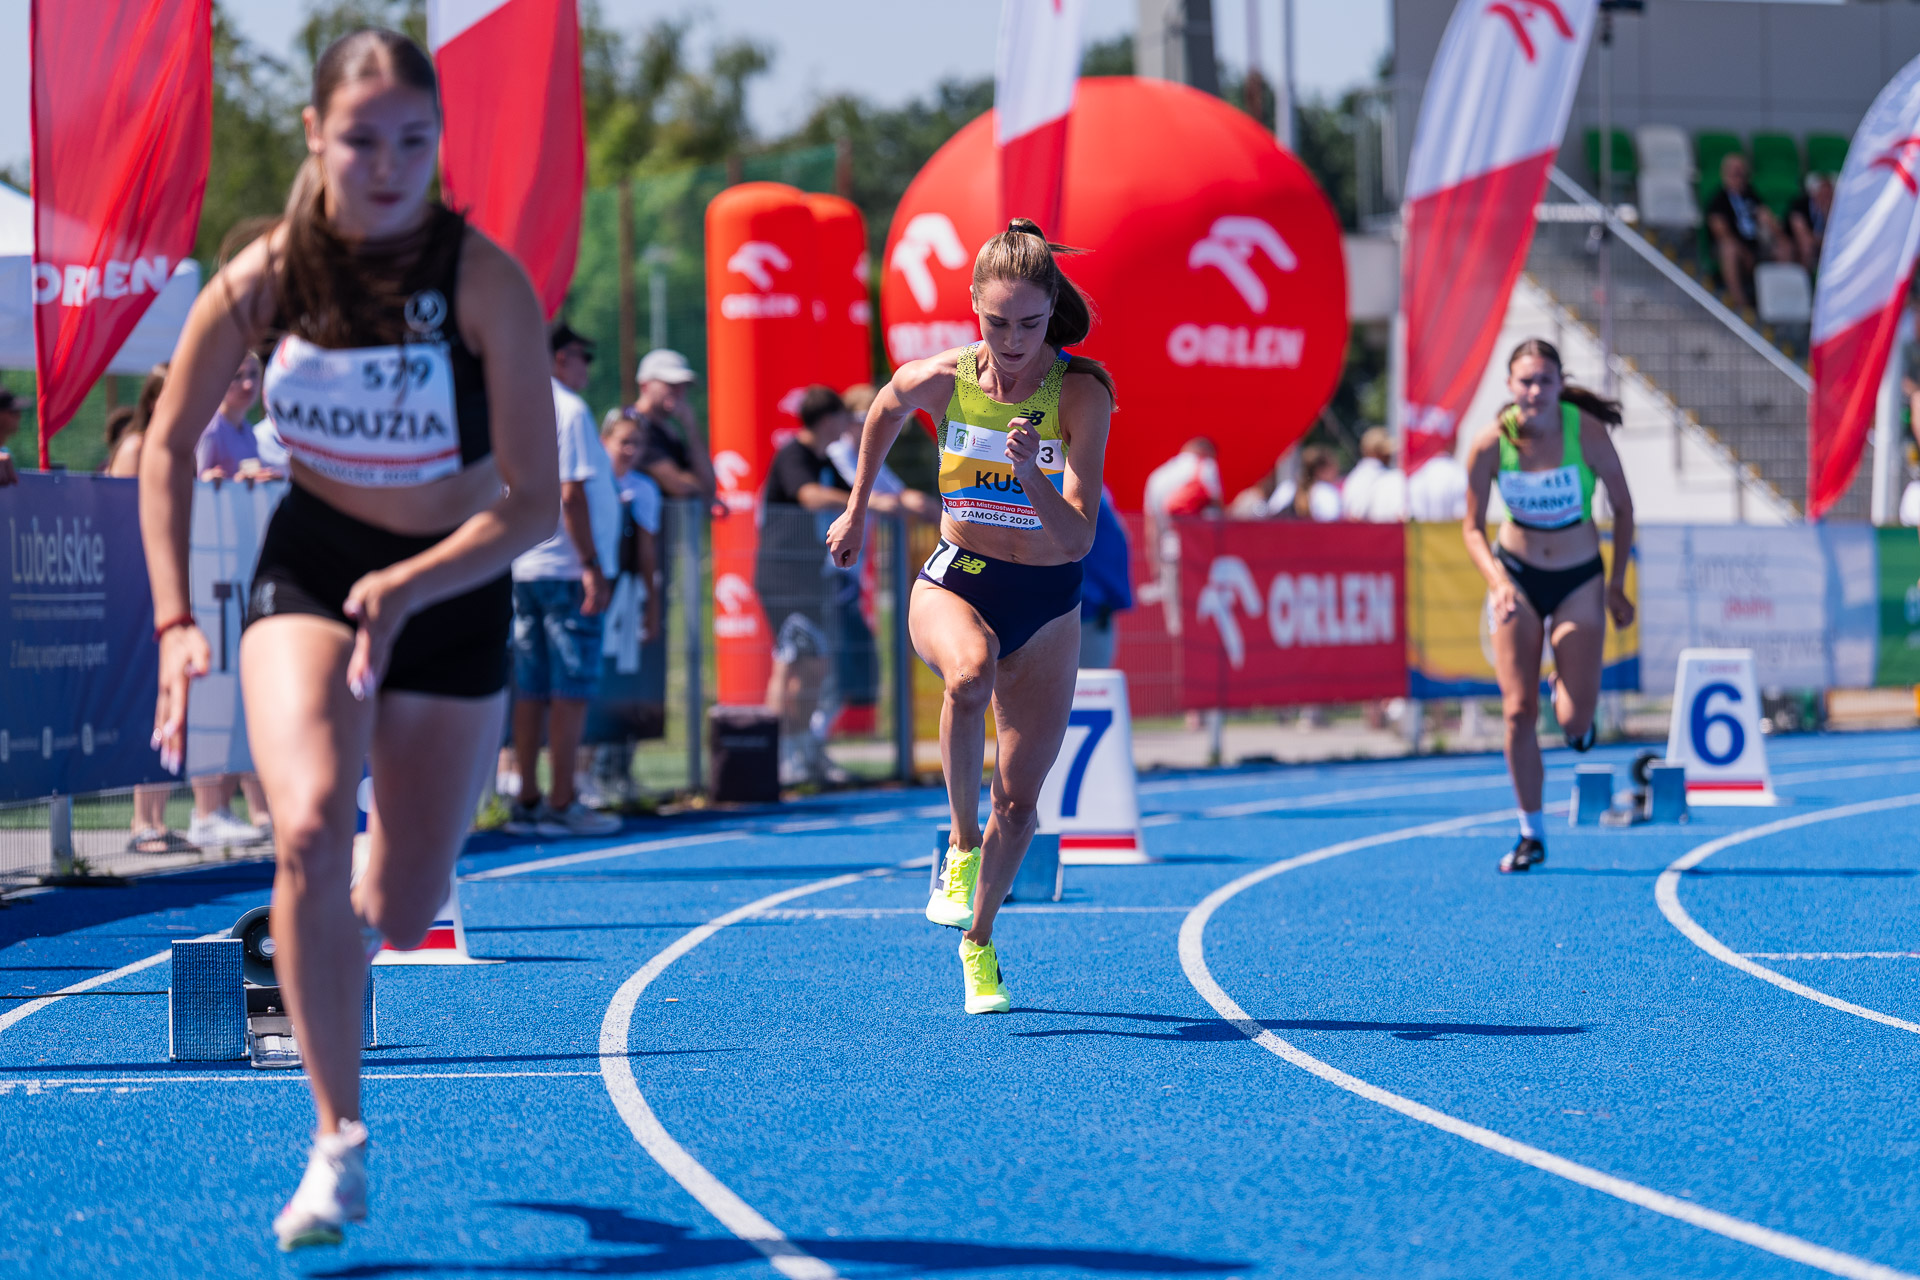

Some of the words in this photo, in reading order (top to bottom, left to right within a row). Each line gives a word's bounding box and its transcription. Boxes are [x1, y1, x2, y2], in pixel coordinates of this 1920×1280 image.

[31, 254, 169, 307] ORLEN
[1166, 322, 1305, 369] ORLEN
[363, 355, 433, 390] 579
[272, 400, 449, 441] MADUZIA
[960, 500, 975, 508] PZLA
[976, 501, 1016, 513] Mistrzostwa
[961, 510, 1008, 522] ZAMOŚĆ
[1009, 514, 1036, 526] 2026
[9, 515, 105, 586] Lubelskie
[1267, 571, 1395, 648] ORLEN
[1690, 682, 1745, 766] 6
[1060, 709, 1113, 817] 7
